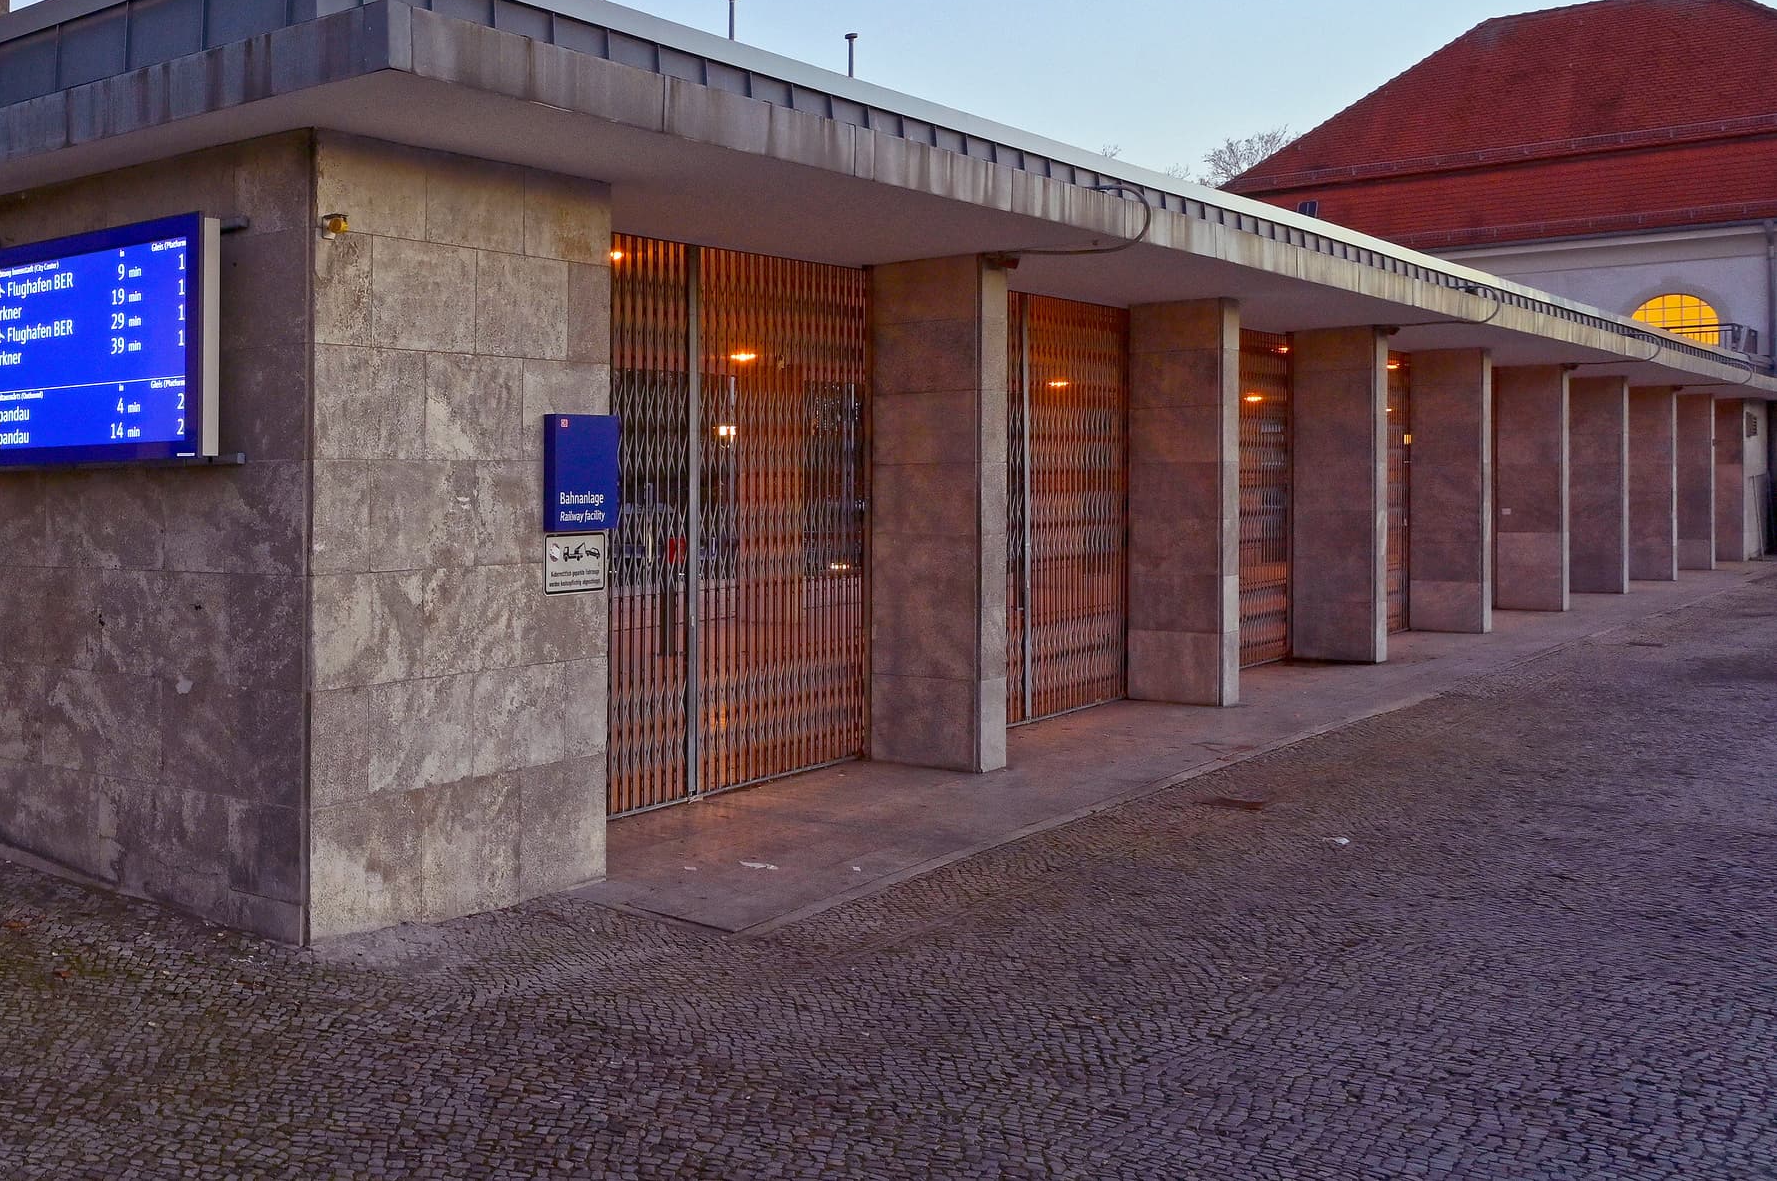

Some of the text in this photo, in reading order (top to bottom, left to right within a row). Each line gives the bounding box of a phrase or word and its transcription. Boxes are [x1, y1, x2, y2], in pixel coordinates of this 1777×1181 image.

[7, 276, 52, 299] Flughafen
[54, 272, 74, 290] BER
[117, 263, 125, 281] 9
[128, 266, 142, 278] min
[178, 253, 185, 270] 1
[111, 287, 125, 306] 19
[128, 290, 142, 303] min
[178, 278, 185, 296] 1
[7, 322, 52, 345] Flughafen
[53, 319, 74, 337] BER
[110, 312, 125, 330] 29
[128, 315, 142, 327] min
[178, 303, 185, 321] 1
[110, 337, 125, 355] 39
[128, 340, 142, 352] min
[178, 329, 185, 347] 1
[116, 397, 124, 414] 4
[127, 401, 141, 413] min
[177, 392, 185, 410] 2
[110, 421, 124, 439] 14
[127, 426, 141, 438] min
[176, 418, 185, 435] 2
[559, 490, 604, 507] Bahnanlage
[559, 509, 606, 523] Railway facility
